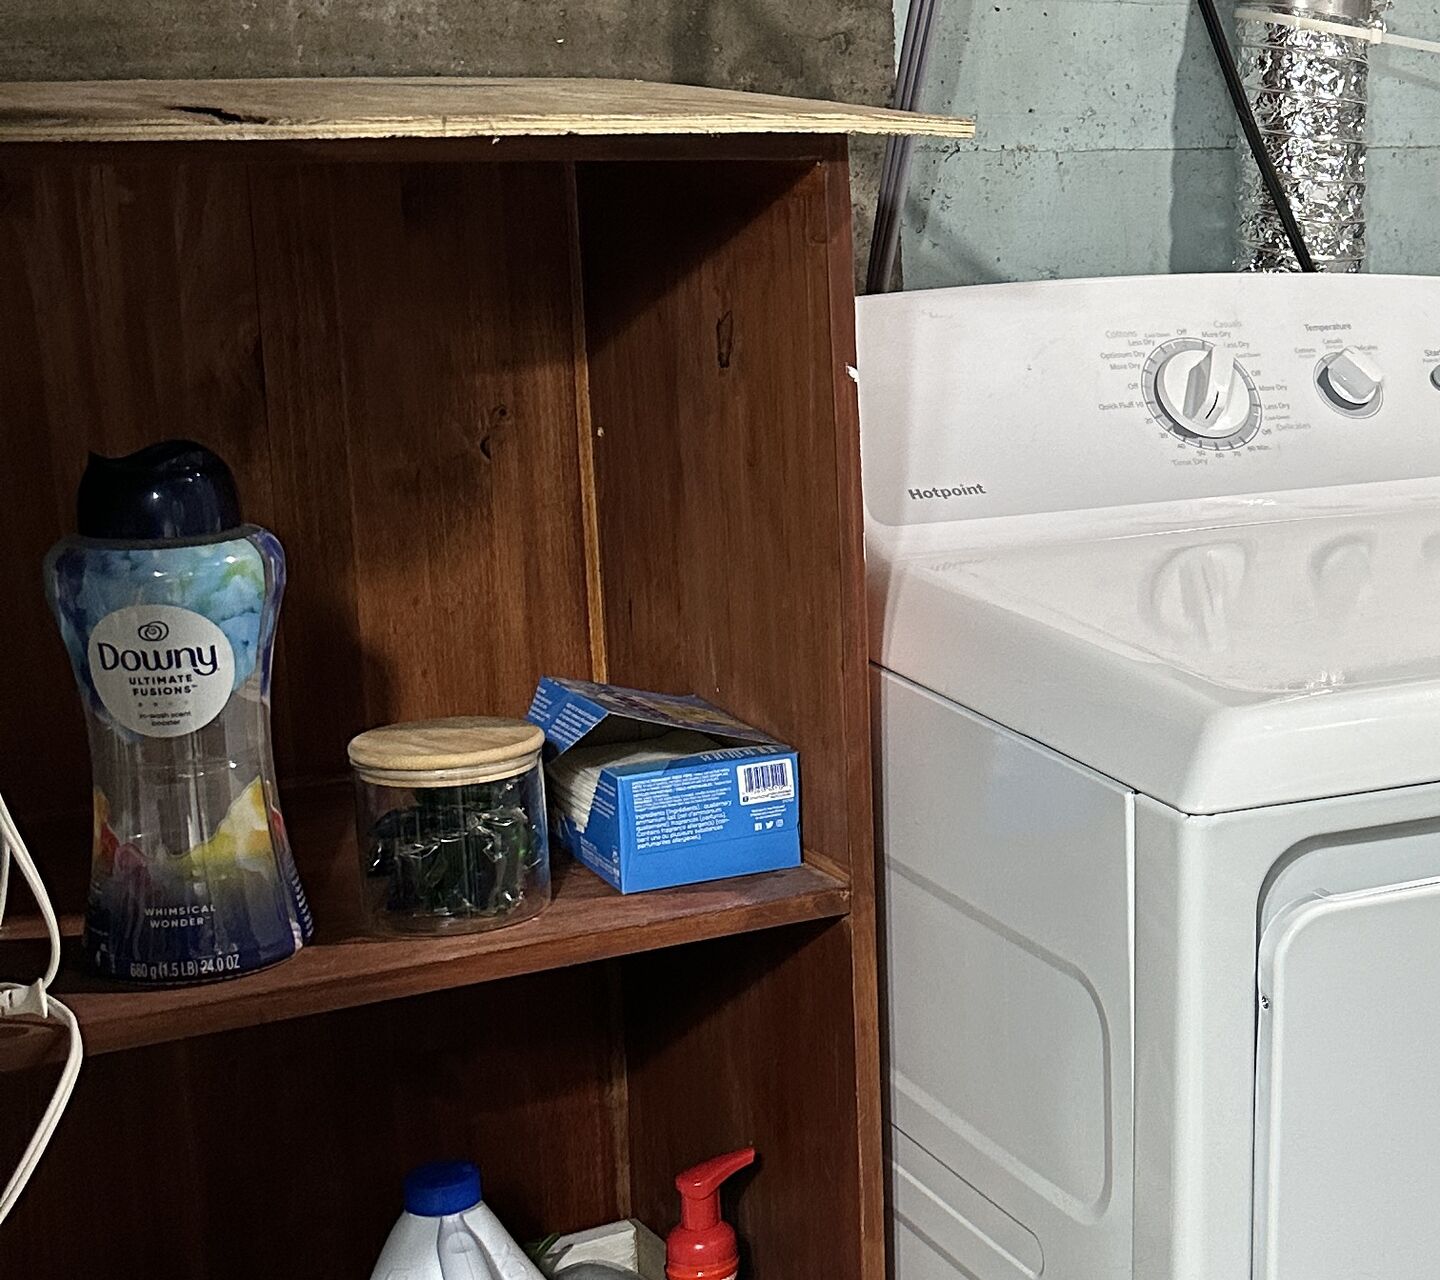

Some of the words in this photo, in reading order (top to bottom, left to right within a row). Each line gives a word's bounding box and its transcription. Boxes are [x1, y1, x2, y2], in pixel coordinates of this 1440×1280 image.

[1304, 323, 1352, 332] Temperature
[1217, 330, 1231, 338] Dry
[1128, 339, 1141, 347] Less
[1142, 338, 1156, 347] Dry
[1236, 340, 1251, 349] Dry
[1131, 351, 1146, 360] Dry
[1127, 362, 1141, 371] Dry
[908, 483, 987, 500] Hotpoint
[97, 642, 218, 676] Downy
[129, 674, 192, 686] ULTIMATE
[171, 710, 191, 718] scent
[151, 719, 181, 727] booster
[144, 904, 216, 917] WHIMSICAL
[130, 962, 148, 978] 680
[150, 964, 157, 980] g
[200, 956, 223, 975] 24.0
[226, 953, 241, 971] OZ
